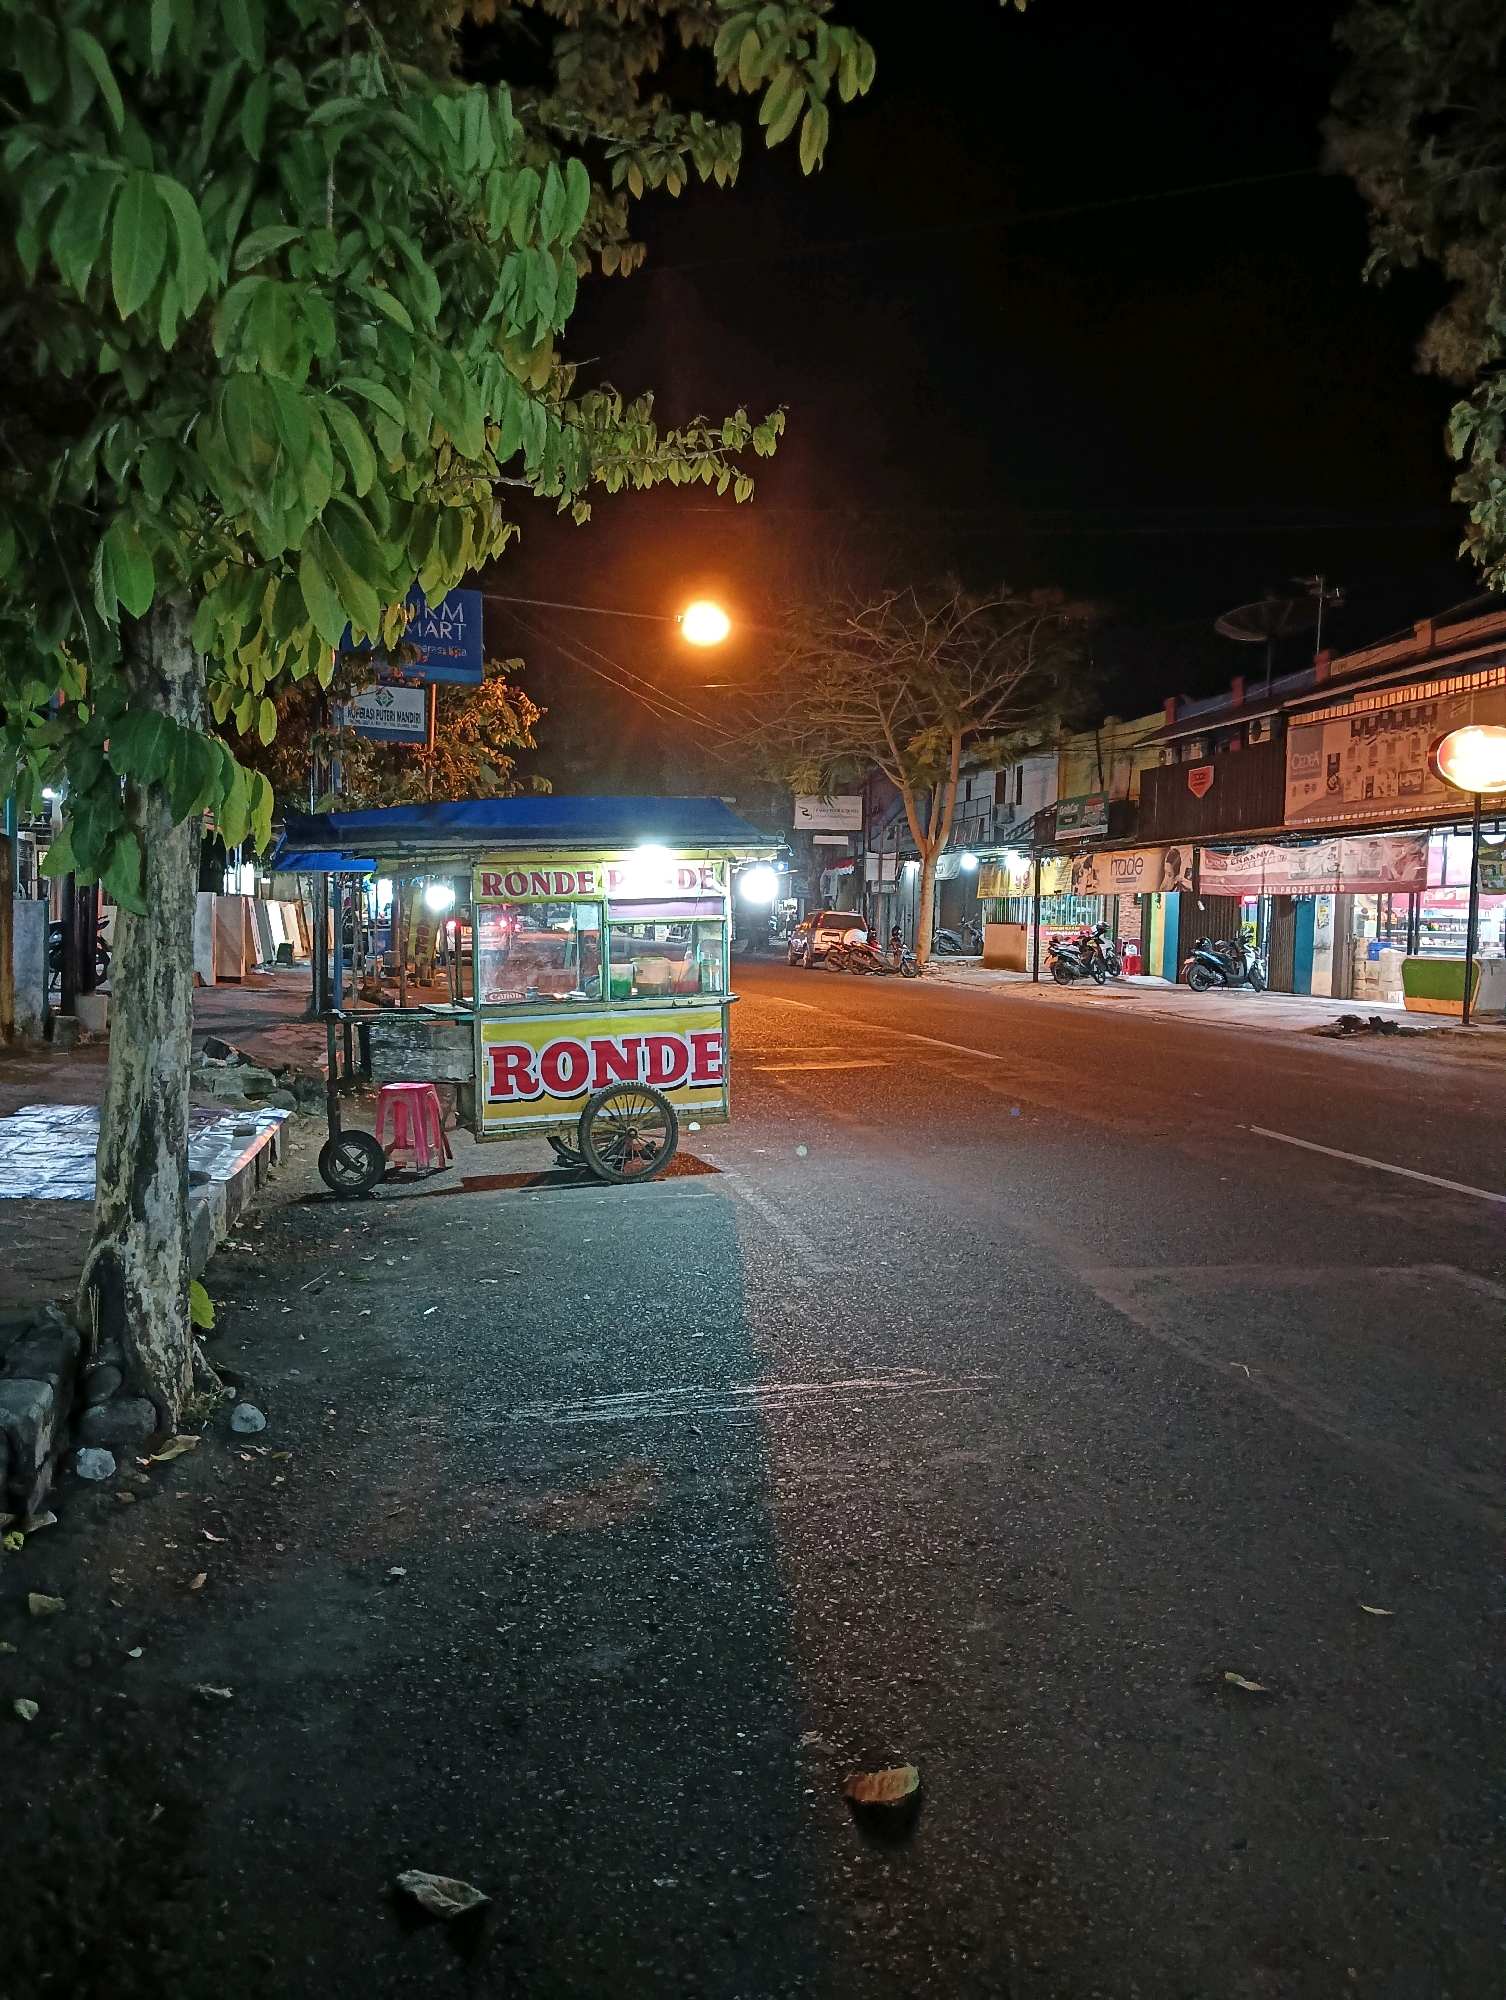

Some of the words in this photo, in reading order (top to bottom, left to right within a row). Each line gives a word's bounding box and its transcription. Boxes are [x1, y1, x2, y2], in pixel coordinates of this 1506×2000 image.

[406, 620, 466, 641] MART
[481, 870, 595, 897] RONDE
[1280, 885, 1315, 894] FROZEN
[488, 1031, 723, 1096] RONDE
